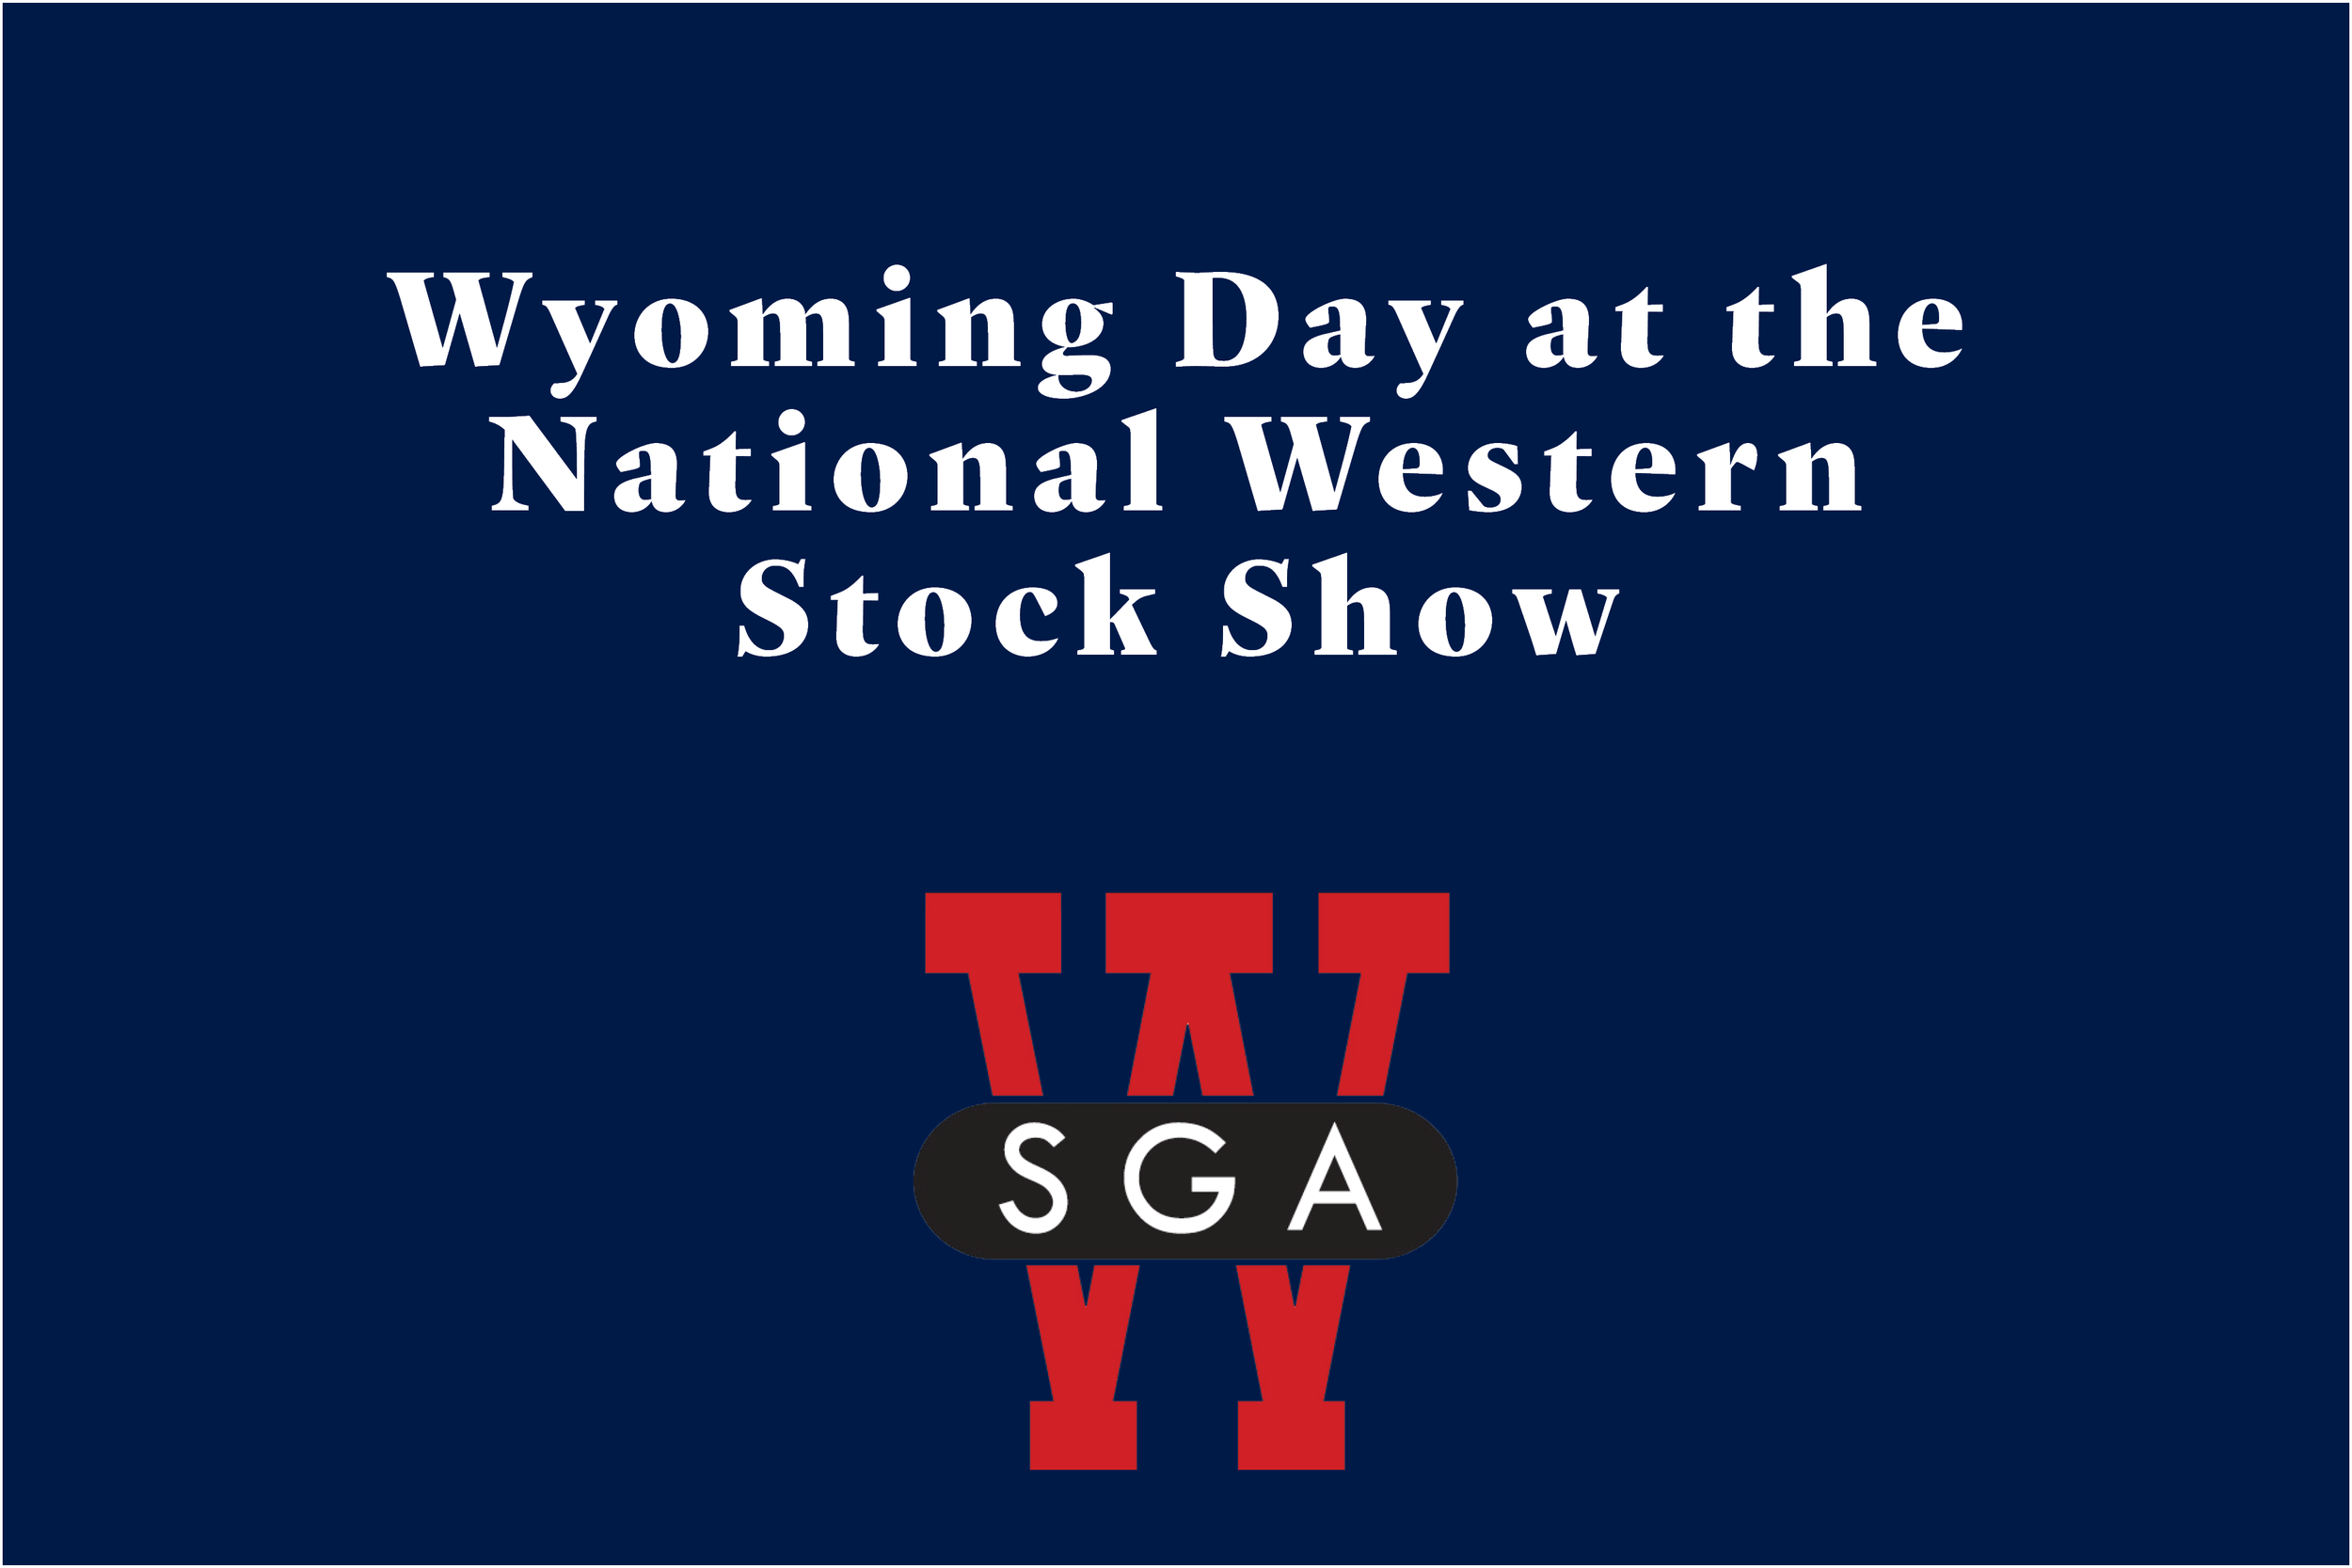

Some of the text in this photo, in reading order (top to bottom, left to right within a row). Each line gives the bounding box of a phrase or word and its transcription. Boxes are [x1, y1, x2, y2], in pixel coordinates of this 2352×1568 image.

[387, 264, 1963, 399] Wyoming Day at the
[489, 408, 1862, 513] National Western
[738, 553, 1619, 657] Stock Show
[999, 1122, 1382, 1234] SGA
